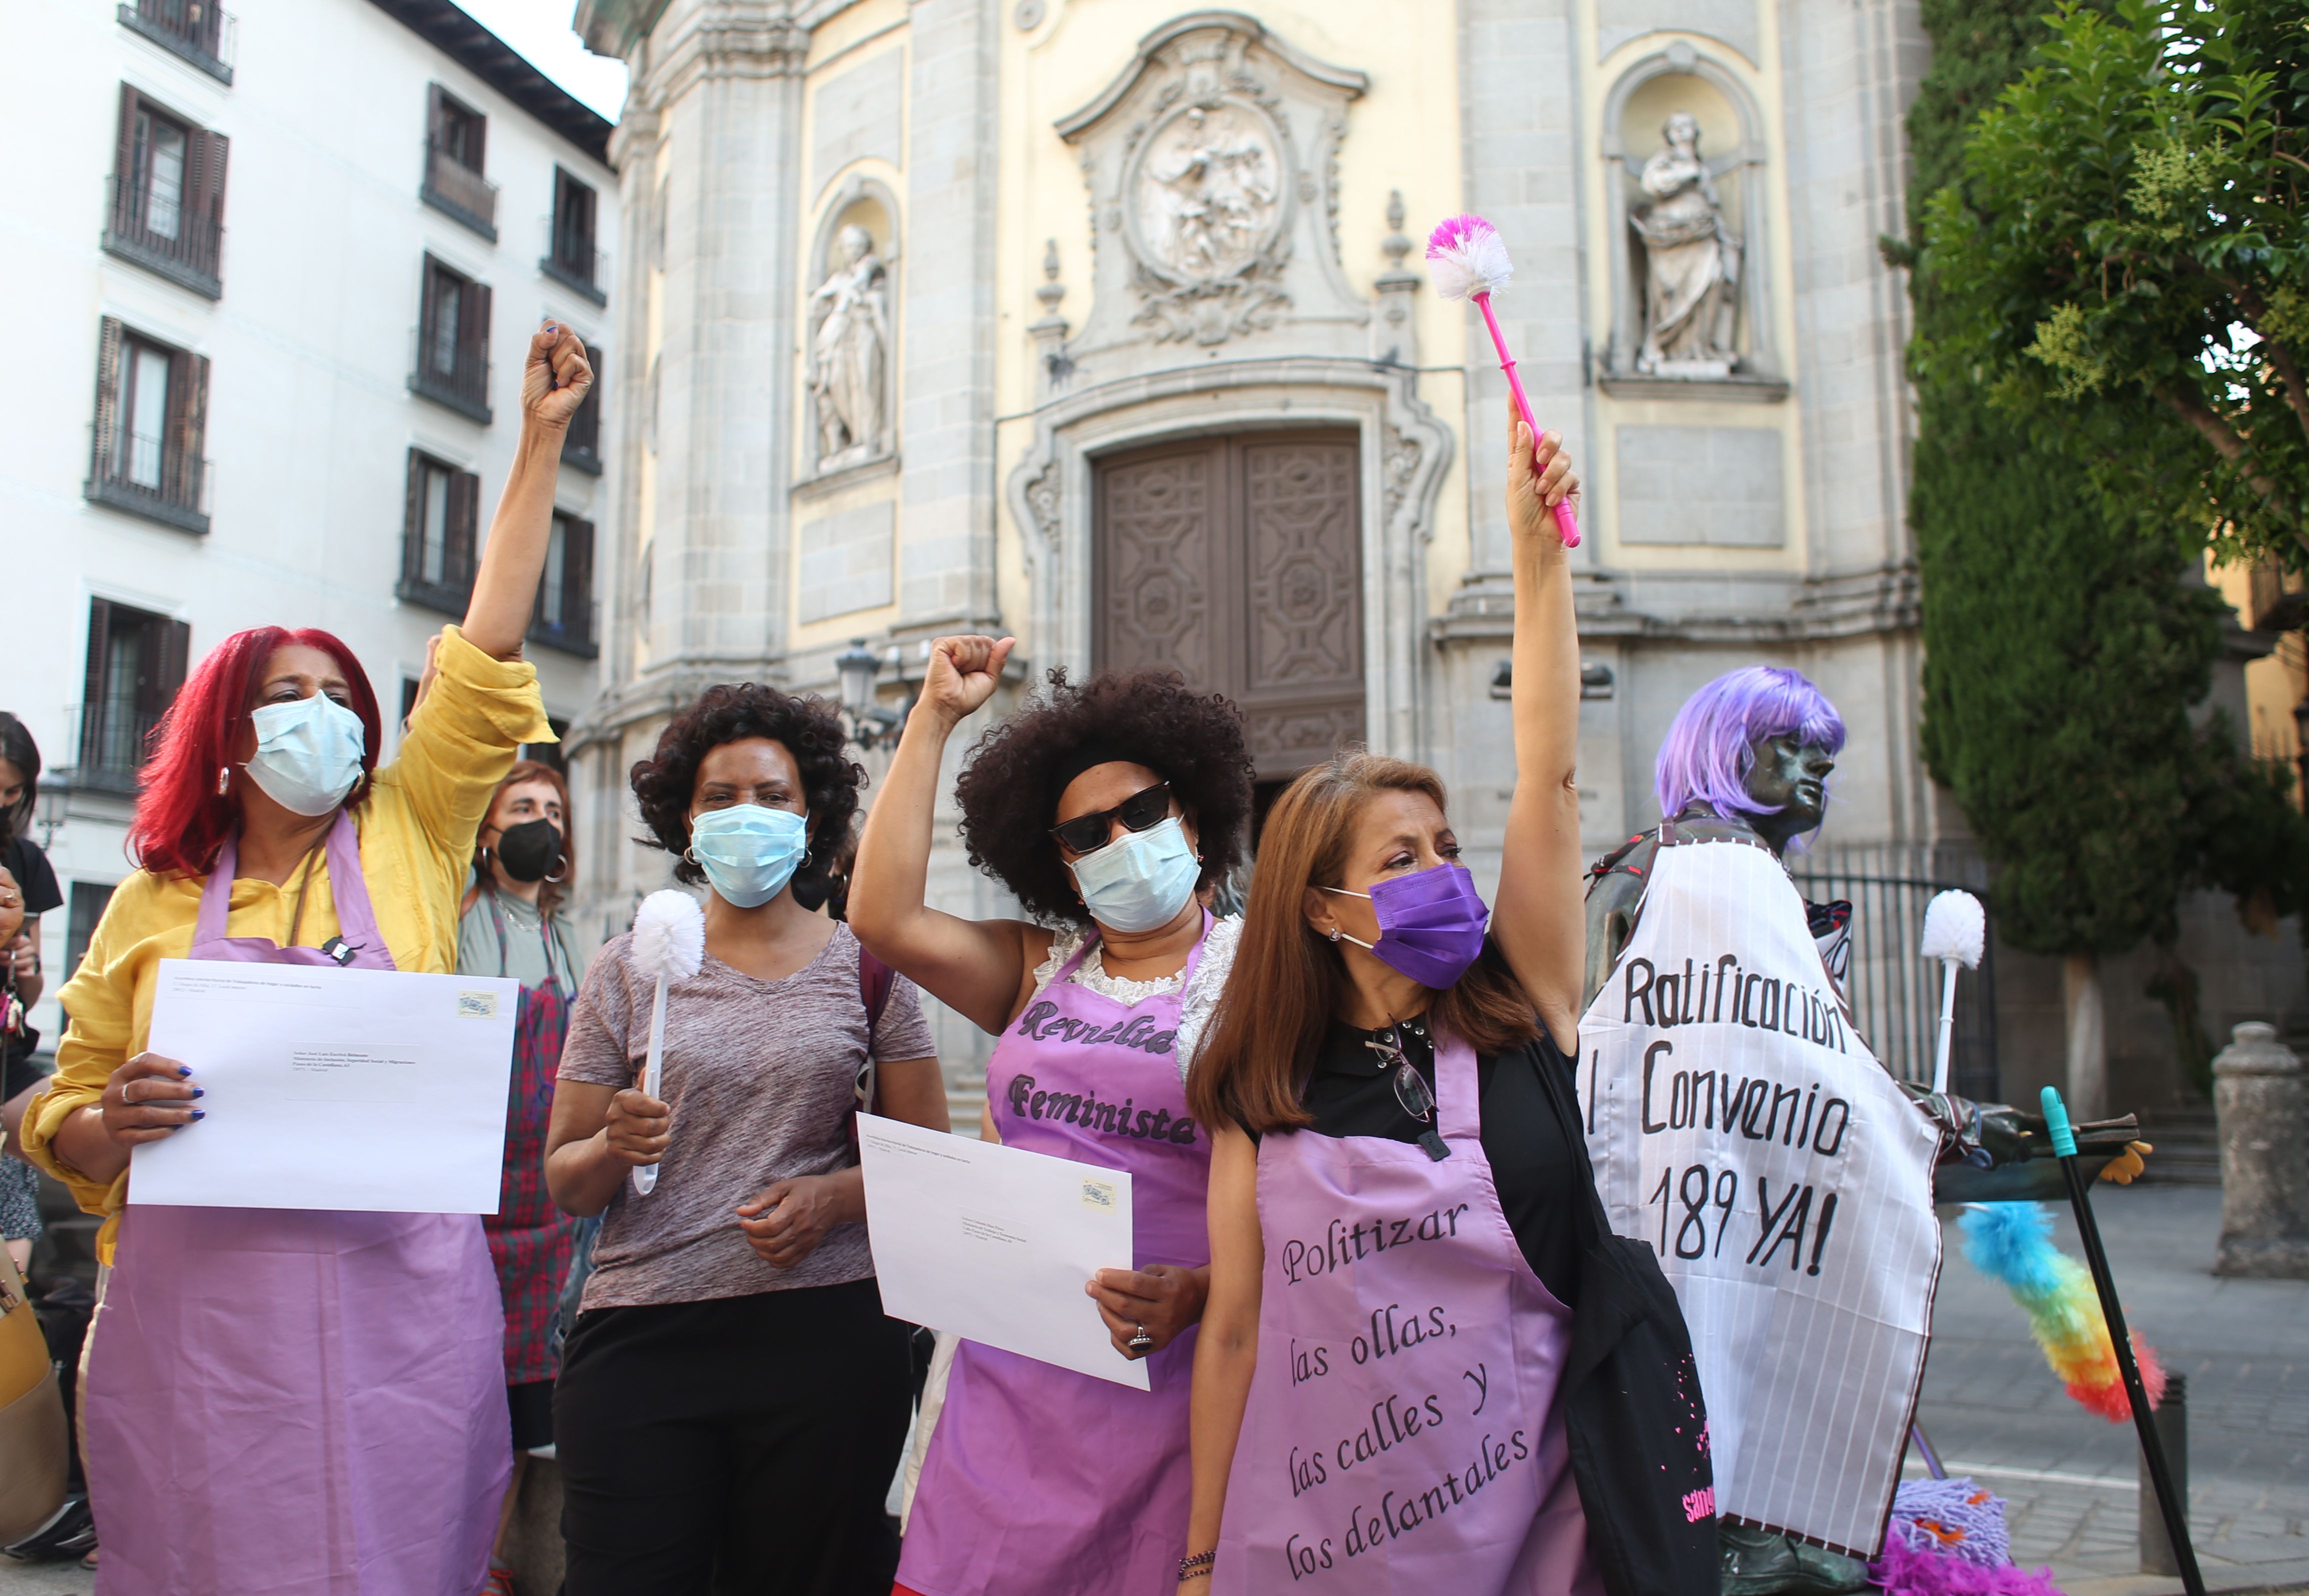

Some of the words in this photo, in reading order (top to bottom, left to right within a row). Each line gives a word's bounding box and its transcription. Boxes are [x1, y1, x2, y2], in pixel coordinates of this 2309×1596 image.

[1624, 954, 1846, 1054] Ratificación
[1009, 1074, 1197, 1144] Feminista
[1642, 1040, 1849, 1157] Convenio
[1282, 1203, 1469, 1286] Politizar
[1650, 1164, 1737, 1260] 189
[1746, 1176, 1838, 1276] YA!
[1290, 1338, 1329, 1388] las
[1351, 1304, 1456, 1365] ollas,
[1289, 1446, 1327, 1498] las
[1337, 1394, 1443, 1470] calles
[1463, 1362, 1487, 1416] y
[1286, 1534, 1333, 1581] los
[1345, 1430, 1529, 1558] delantales
